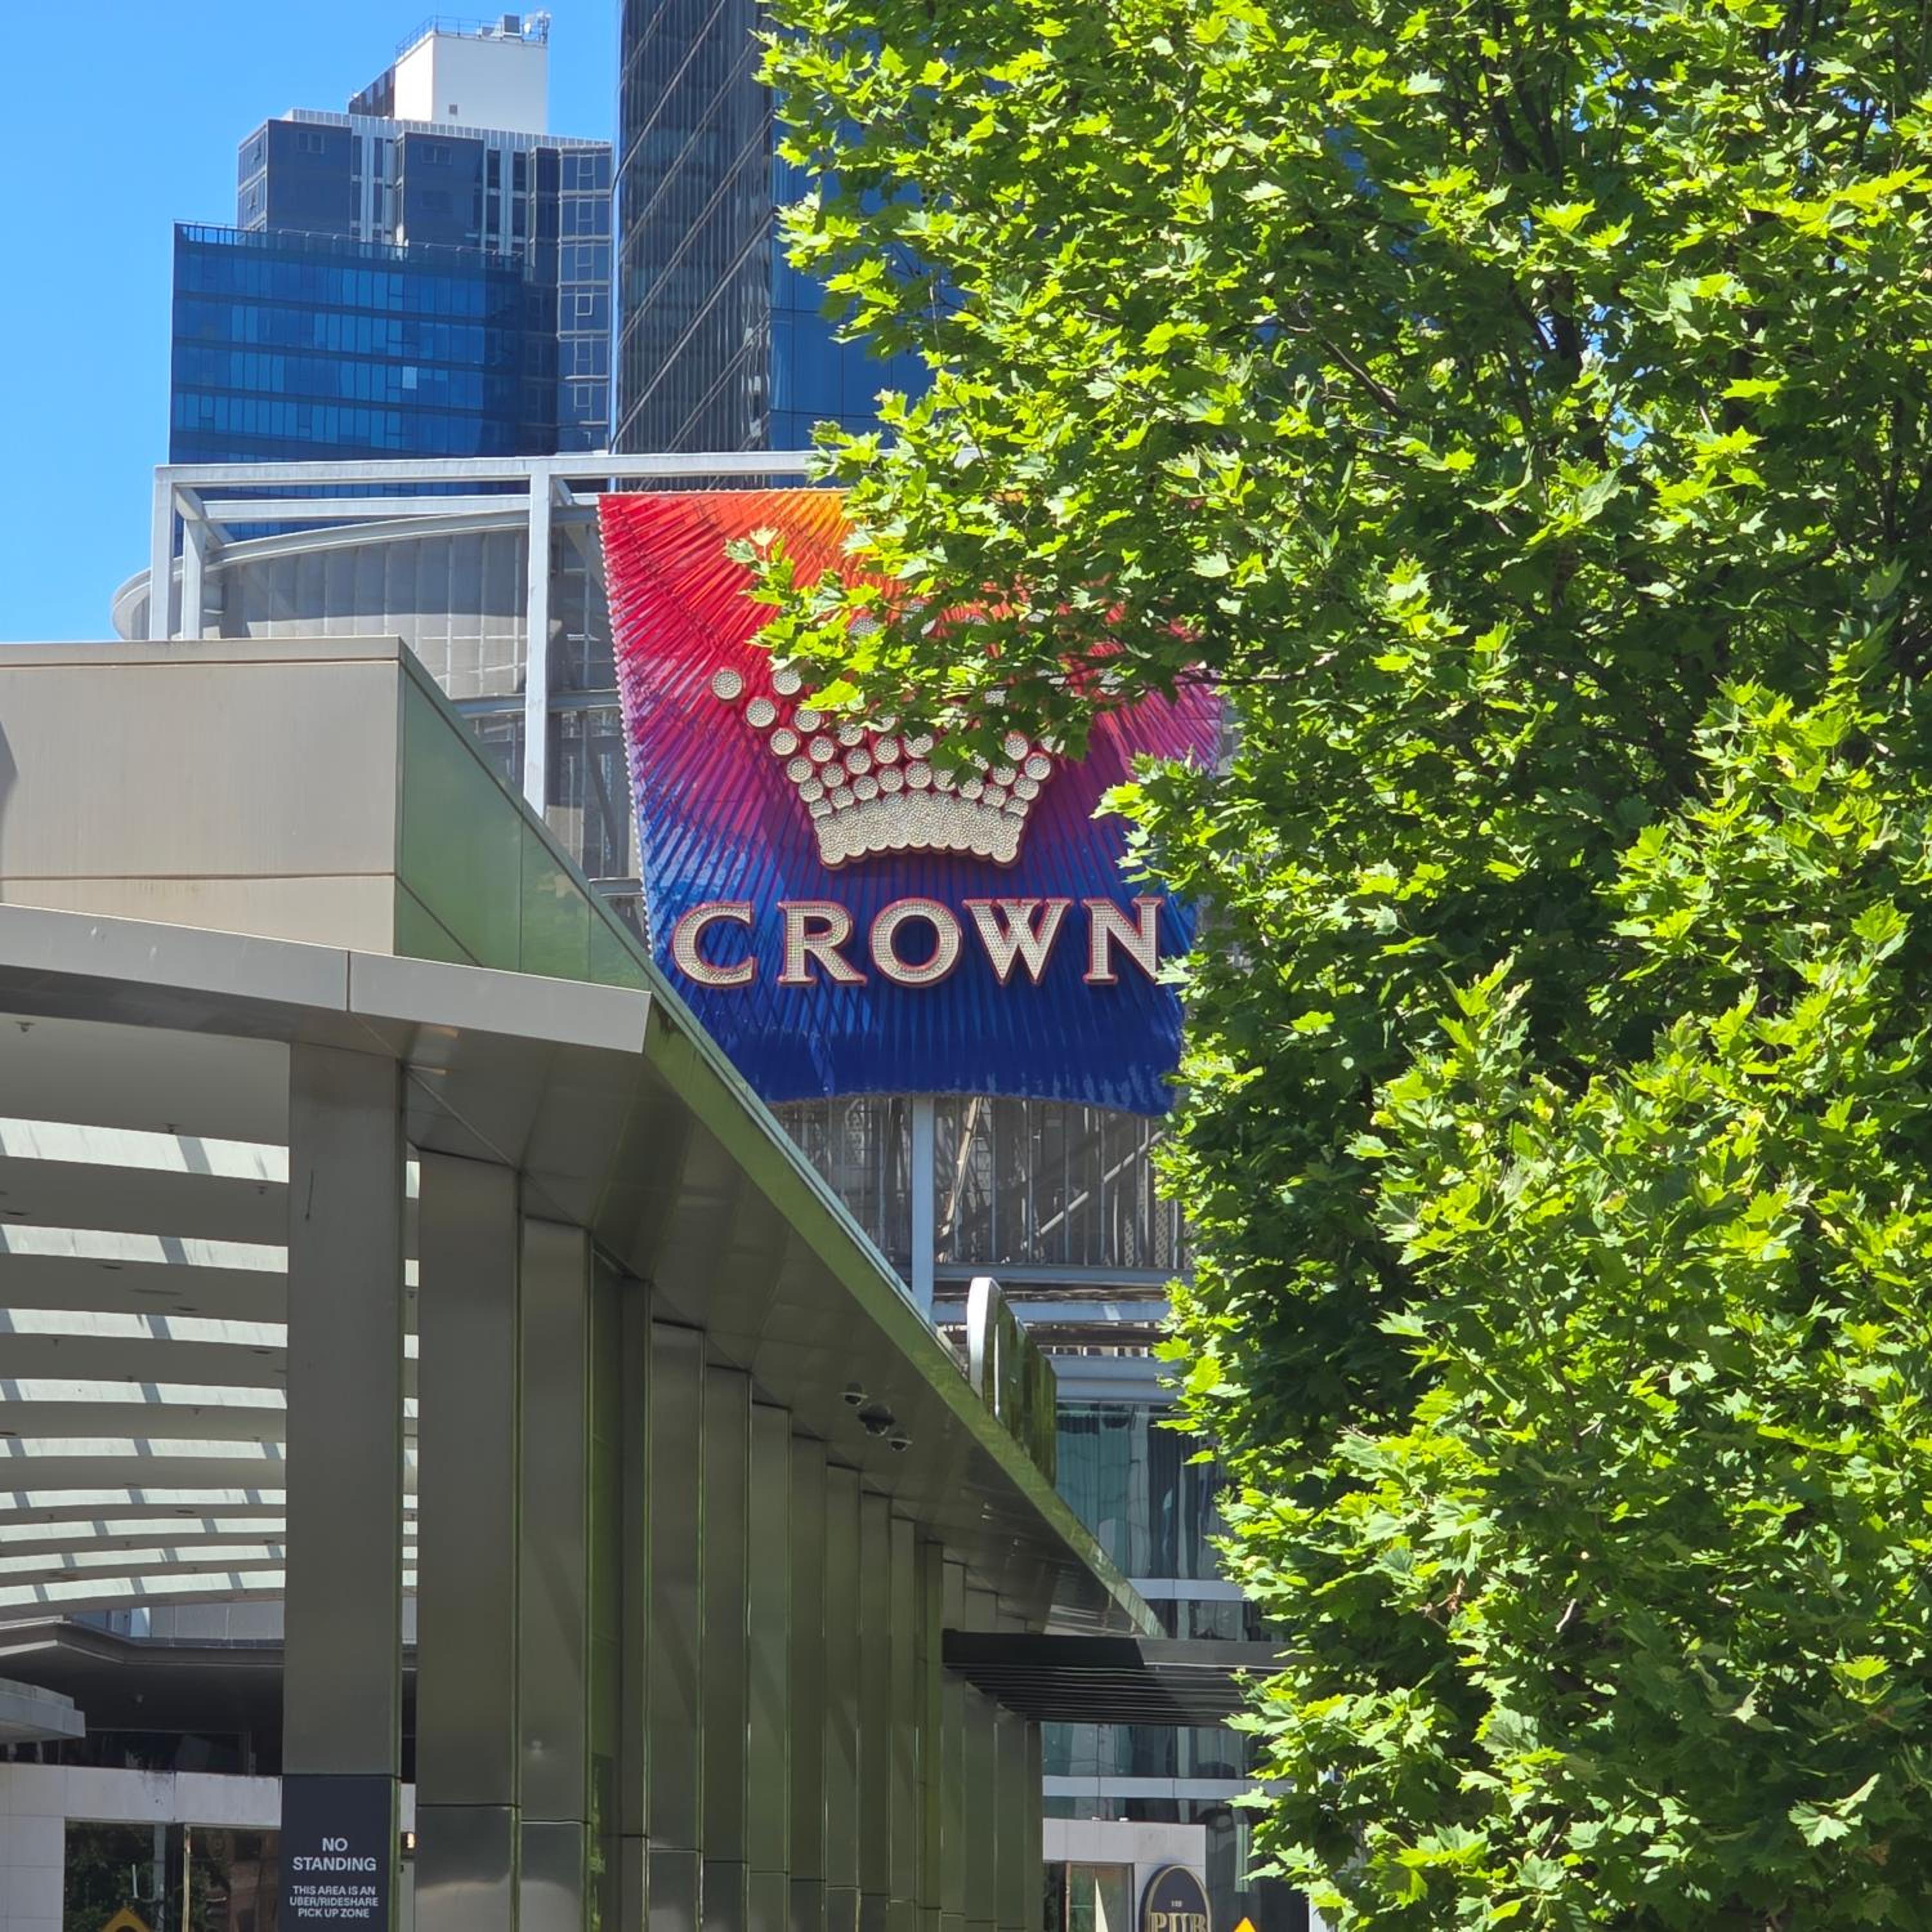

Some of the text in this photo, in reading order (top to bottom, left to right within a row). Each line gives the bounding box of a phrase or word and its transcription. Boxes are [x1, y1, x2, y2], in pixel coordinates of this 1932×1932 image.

[672, 898, 1164, 987] CROWN
[322, 1837, 348, 1852] NO
[292, 1857, 377, 1871] STANDING
[292, 1886, 375, 1895] THIS AREA IS AN
[290, 1897, 379, 1906] UBER/RIDESHARE
[298, 1908, 370, 1918] PICK UP ZONE
[1150, 1912, 1207, 1932] PUB
